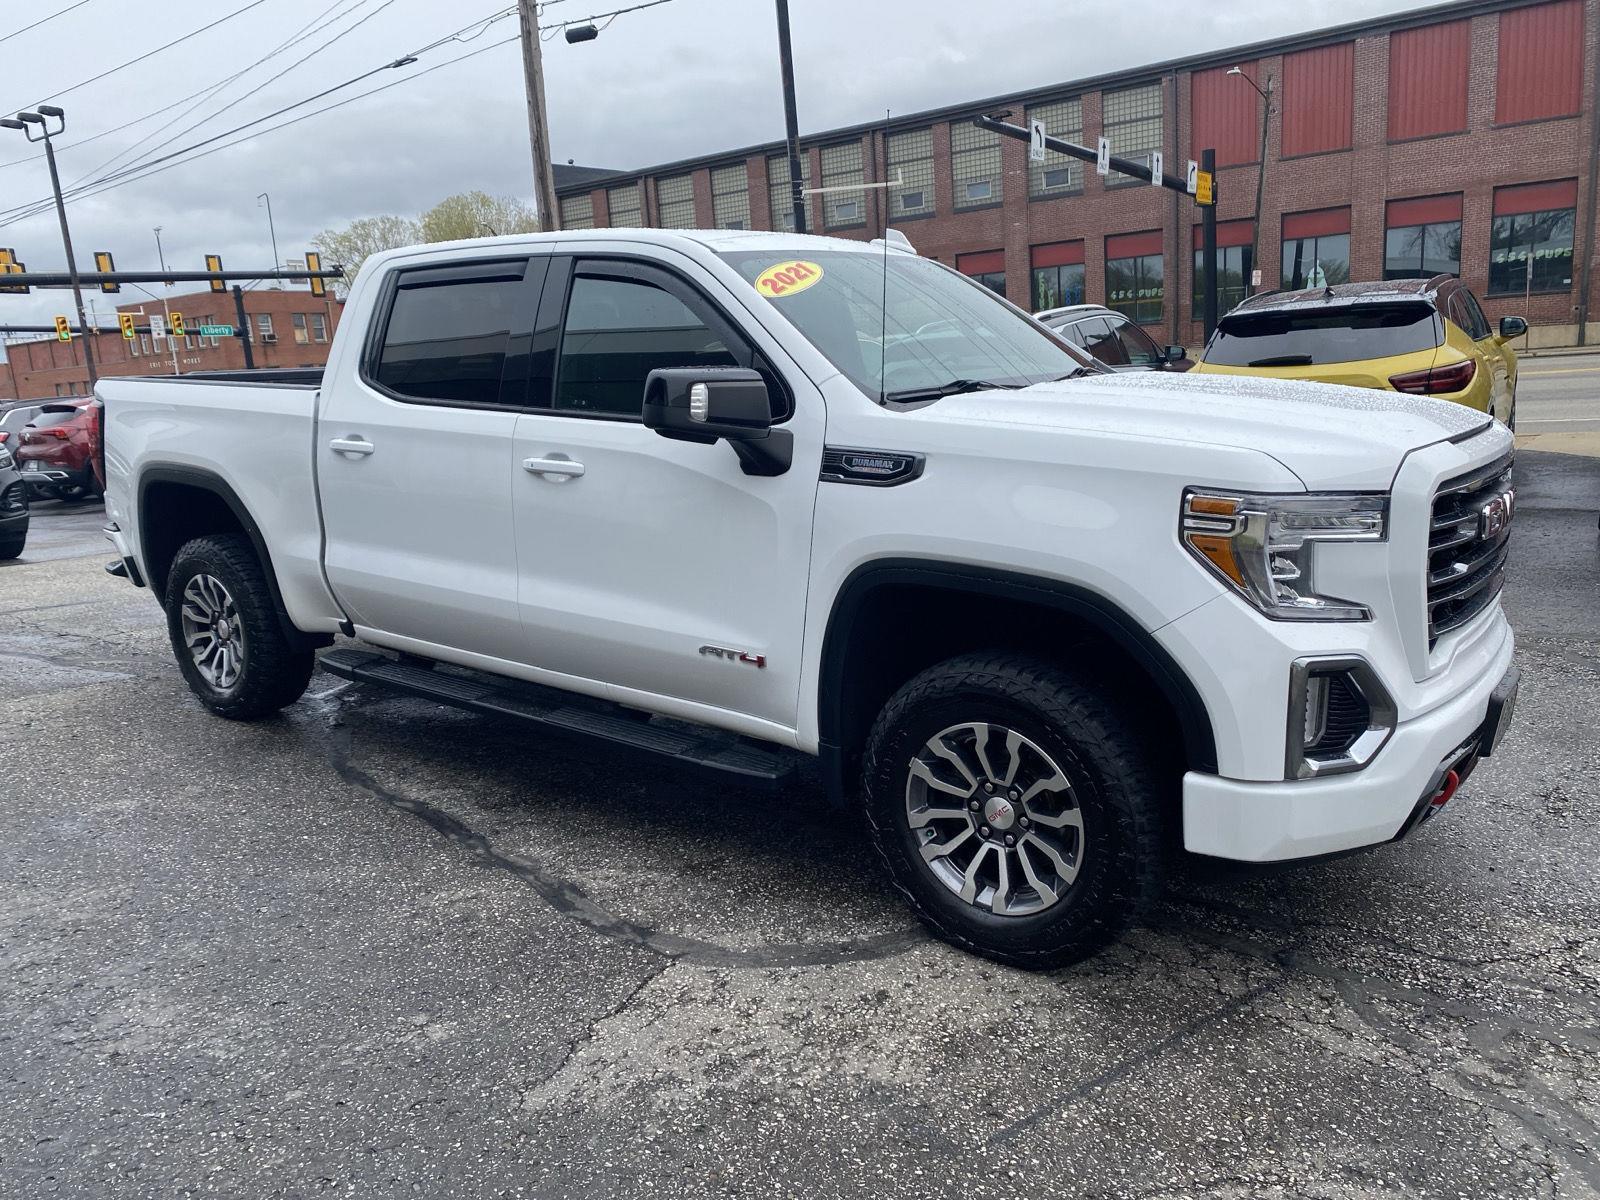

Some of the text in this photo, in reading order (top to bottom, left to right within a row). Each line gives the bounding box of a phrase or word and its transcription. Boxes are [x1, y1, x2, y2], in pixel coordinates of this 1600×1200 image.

[762, 262, 816, 294] 2021
[204, 326, 229, 335] Liberty
[852, 457, 894, 469] DURAMAX
[988, 805, 1010, 822] GMC
